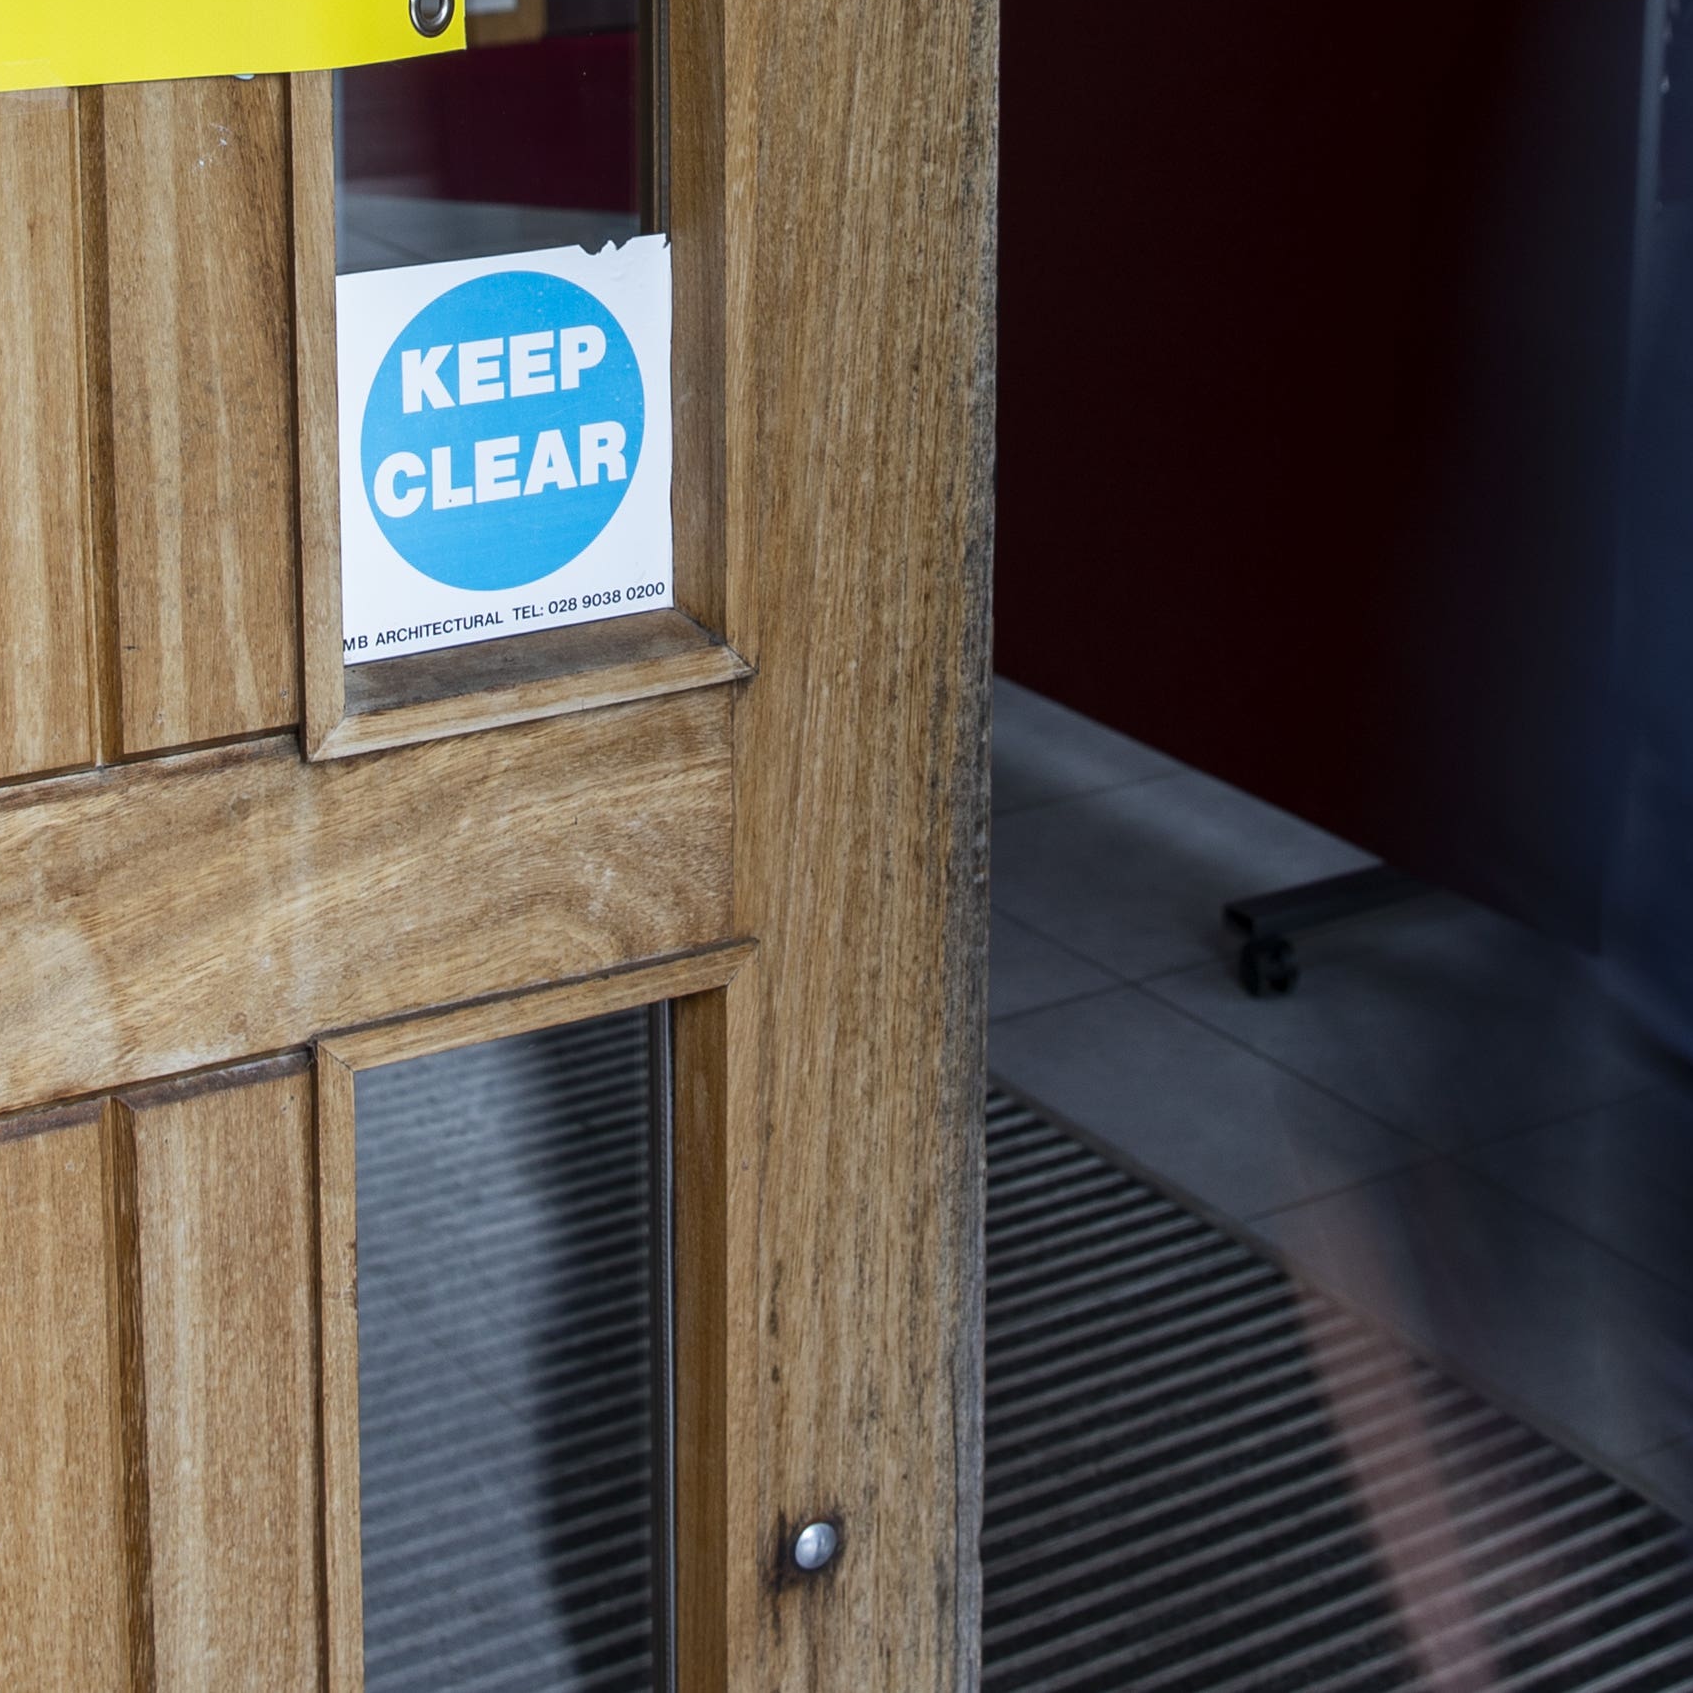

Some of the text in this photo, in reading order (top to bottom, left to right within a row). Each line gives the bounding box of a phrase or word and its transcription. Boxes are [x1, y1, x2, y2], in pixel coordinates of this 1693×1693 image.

[401, 324, 607, 414] KEEP
[373, 420, 628, 519] CLEAR
[375, 611, 504, 646] ARCHITECTURAL
[512, 604, 544, 621] TEL:
[548, 597, 578, 615] 028
[582, 589, 621, 609] 9038
[626, 581, 665, 601] 0200
